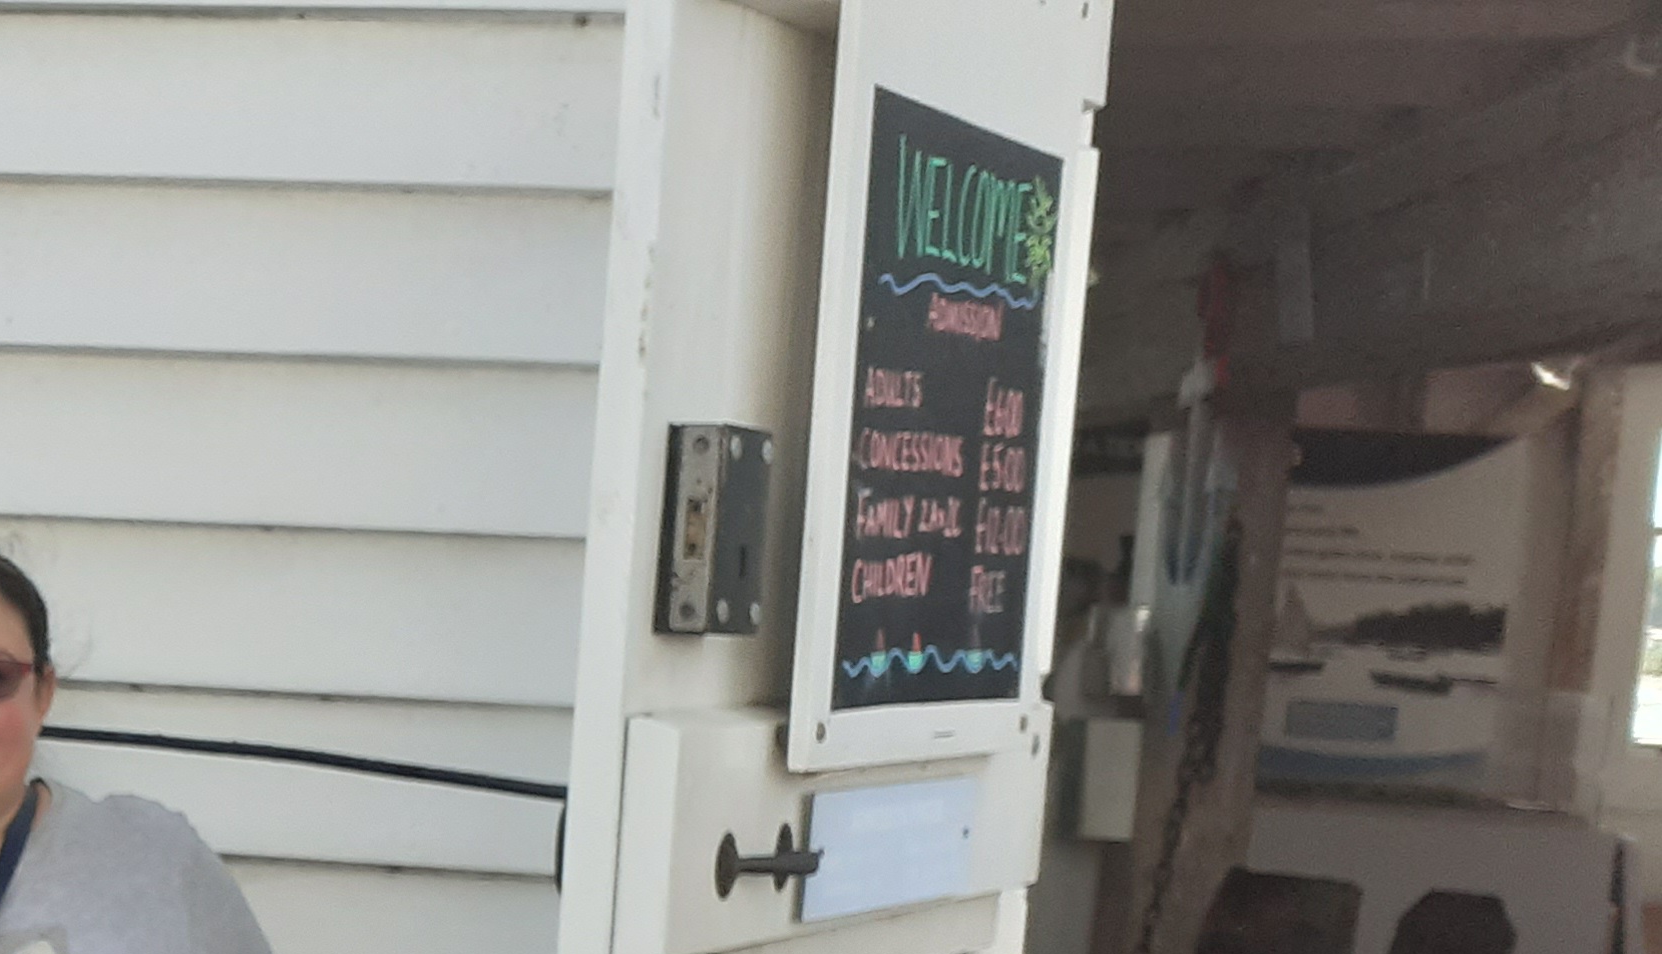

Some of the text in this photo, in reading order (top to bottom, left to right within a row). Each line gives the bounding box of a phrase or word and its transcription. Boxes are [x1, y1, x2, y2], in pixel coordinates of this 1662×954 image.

[897, 133, 1034, 285] WELCOME
[865, 366, 923, 408] ADULTS
[854, 427, 964, 478] CONCESSIONS
[856, 487, 915, 540] FAMILY
[851, 551, 1007, 614] CHILDREN FREE
